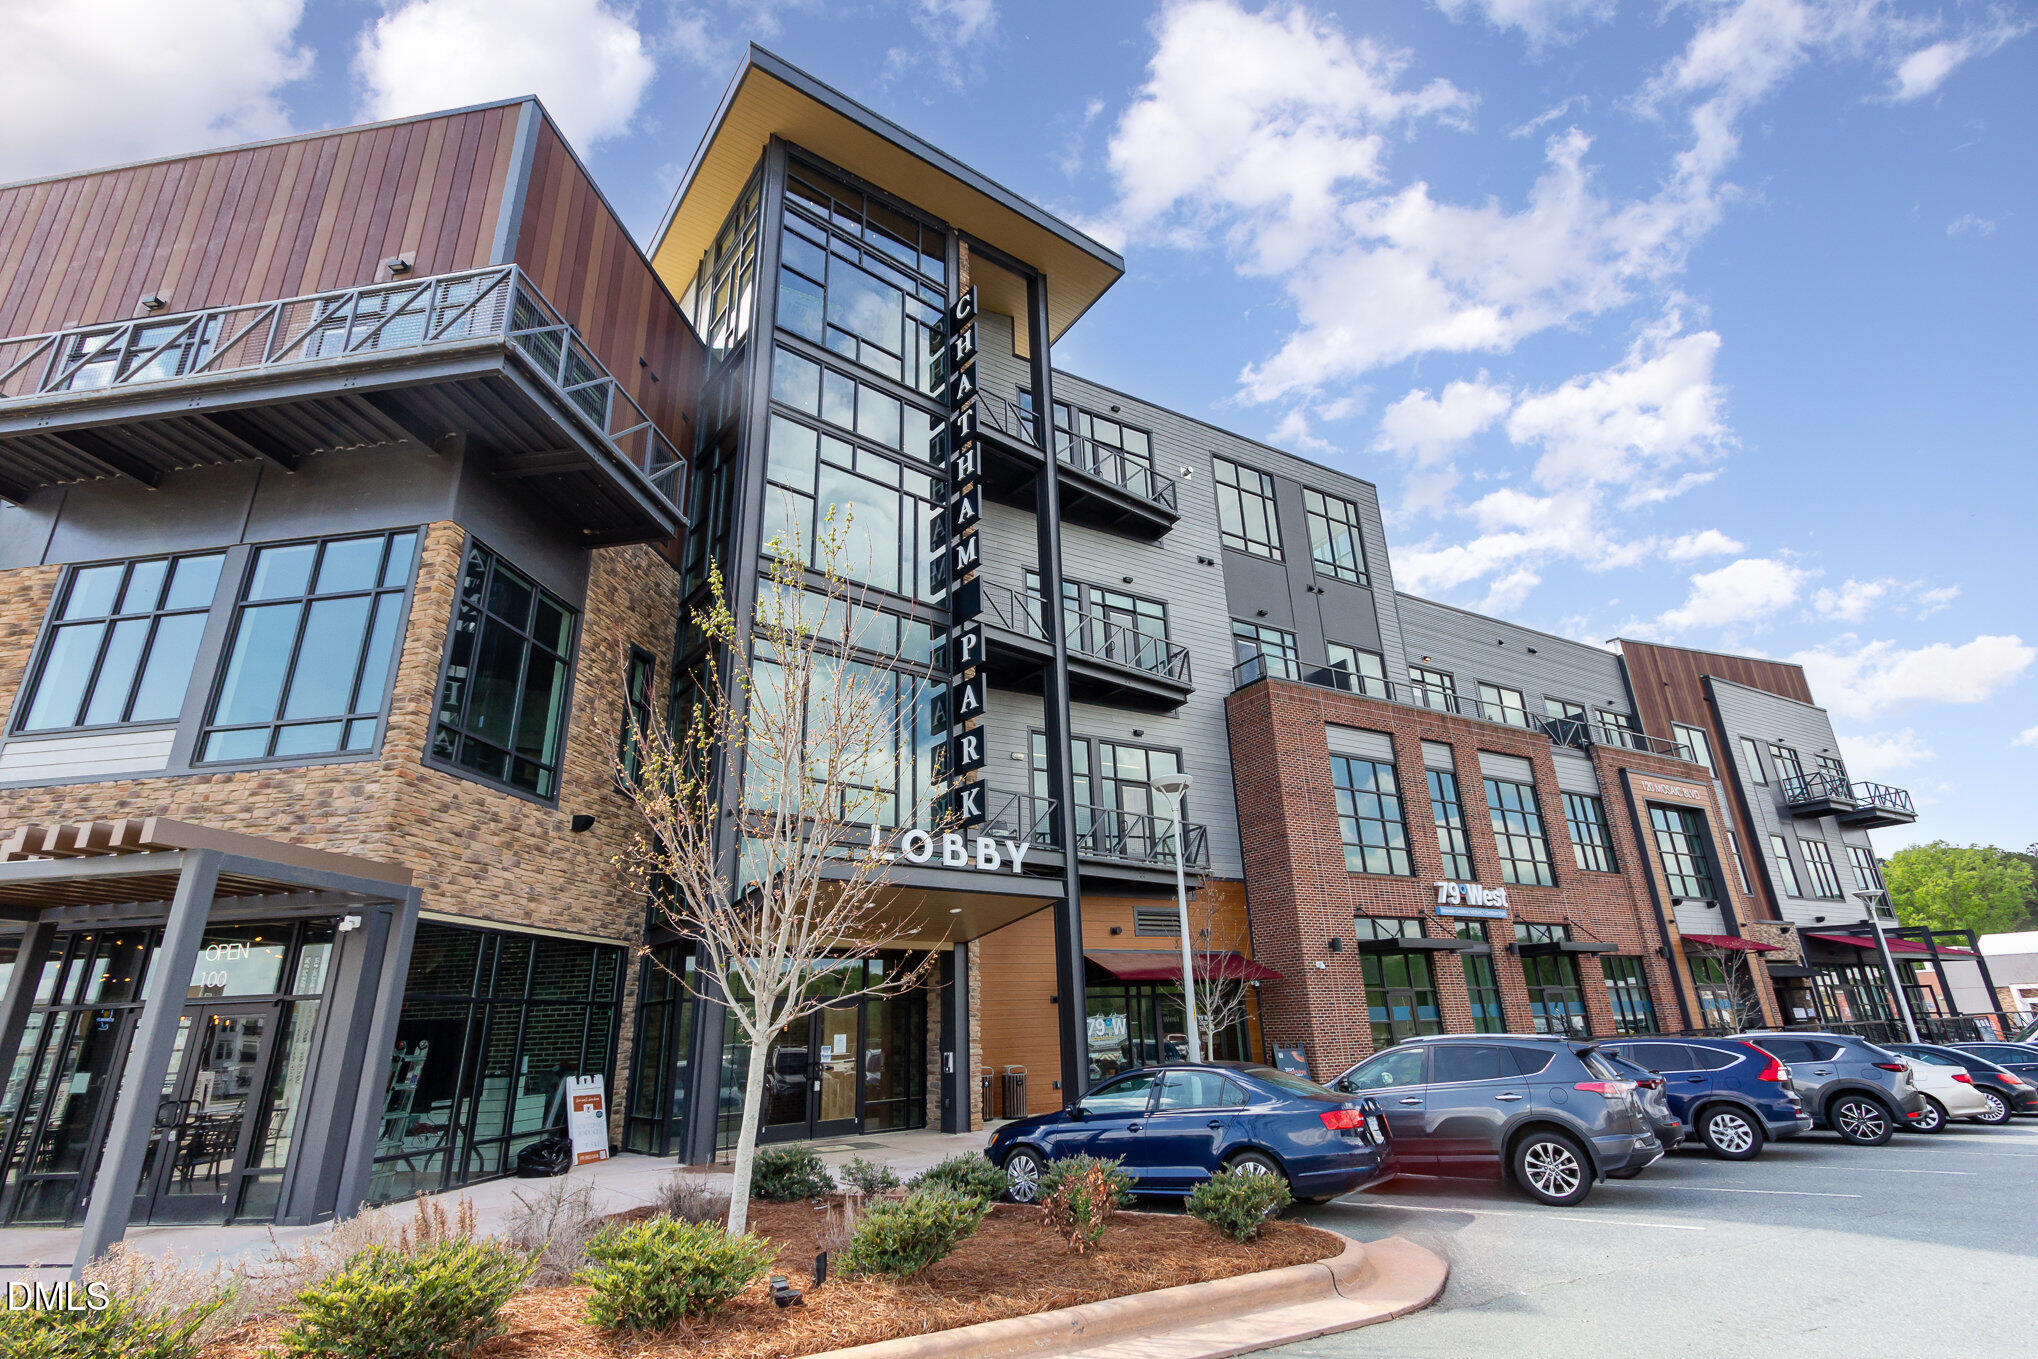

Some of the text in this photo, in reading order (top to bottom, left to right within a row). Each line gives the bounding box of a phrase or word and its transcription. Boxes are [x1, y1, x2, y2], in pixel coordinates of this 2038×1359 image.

[956, 294, 982, 819] CHATHAM PARK
[1641, 781, 1700, 799] 120 MOSAIC BLVD
[870, 824, 1031, 874] LOBBY
[205, 942, 250, 961] OPEN
[200, 971, 228, 987] 100
